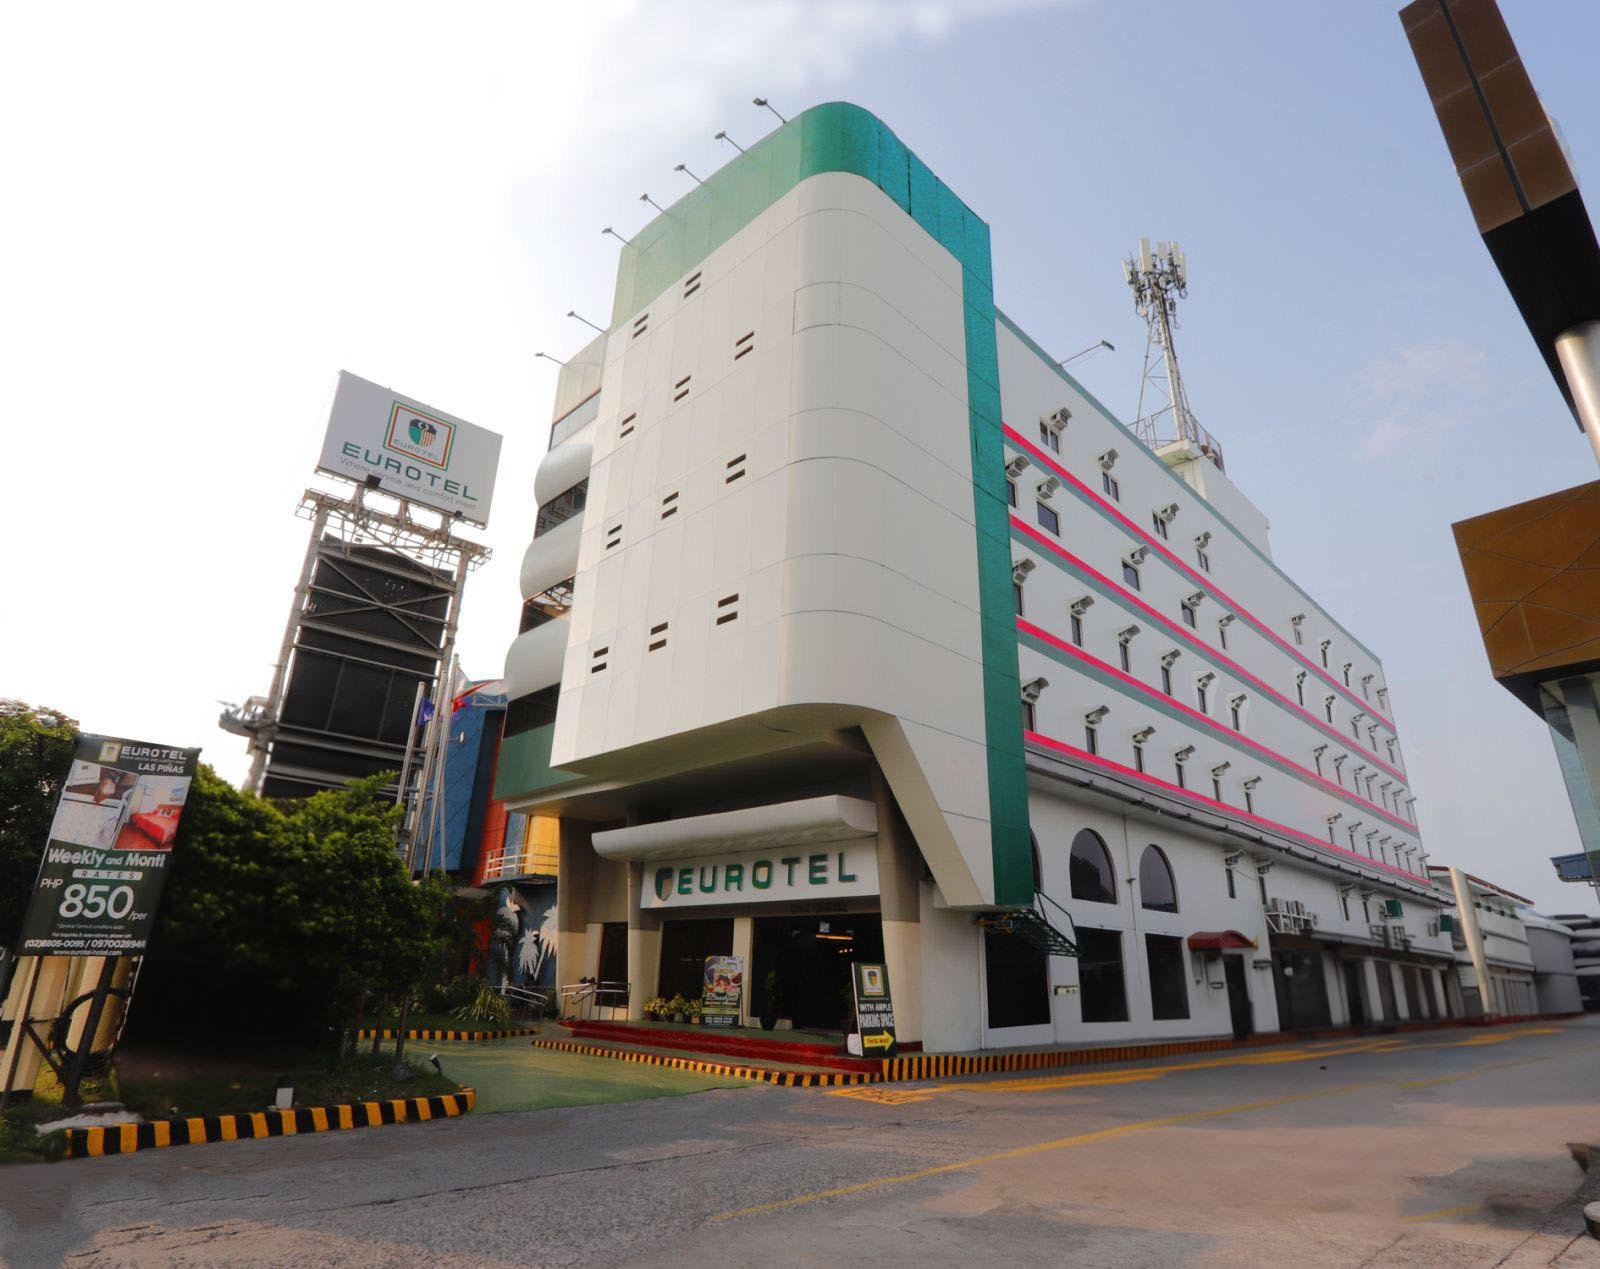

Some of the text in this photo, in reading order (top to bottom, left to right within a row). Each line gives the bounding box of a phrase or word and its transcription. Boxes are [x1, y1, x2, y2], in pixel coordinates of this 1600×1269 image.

[342, 441, 477, 501] EUROTEL
[404, 482, 421, 492] and
[423, 488, 454, 503] comfort
[121, 745, 187, 760] EUROTEL
[138, 763, 184, 773] LAS PIÑAS
[48, 848, 106, 868] Weekly
[105, 857, 123, 865] and
[82, 871, 134, 879] RATES
[677, 852, 857, 895] EUROTEL
[40, 878, 64, 888] PHP
[59, 883, 134, 919] 850
[859, 1003, 874, 1012] WITH
[859, 1013, 894, 1028] PARKING SPACE
